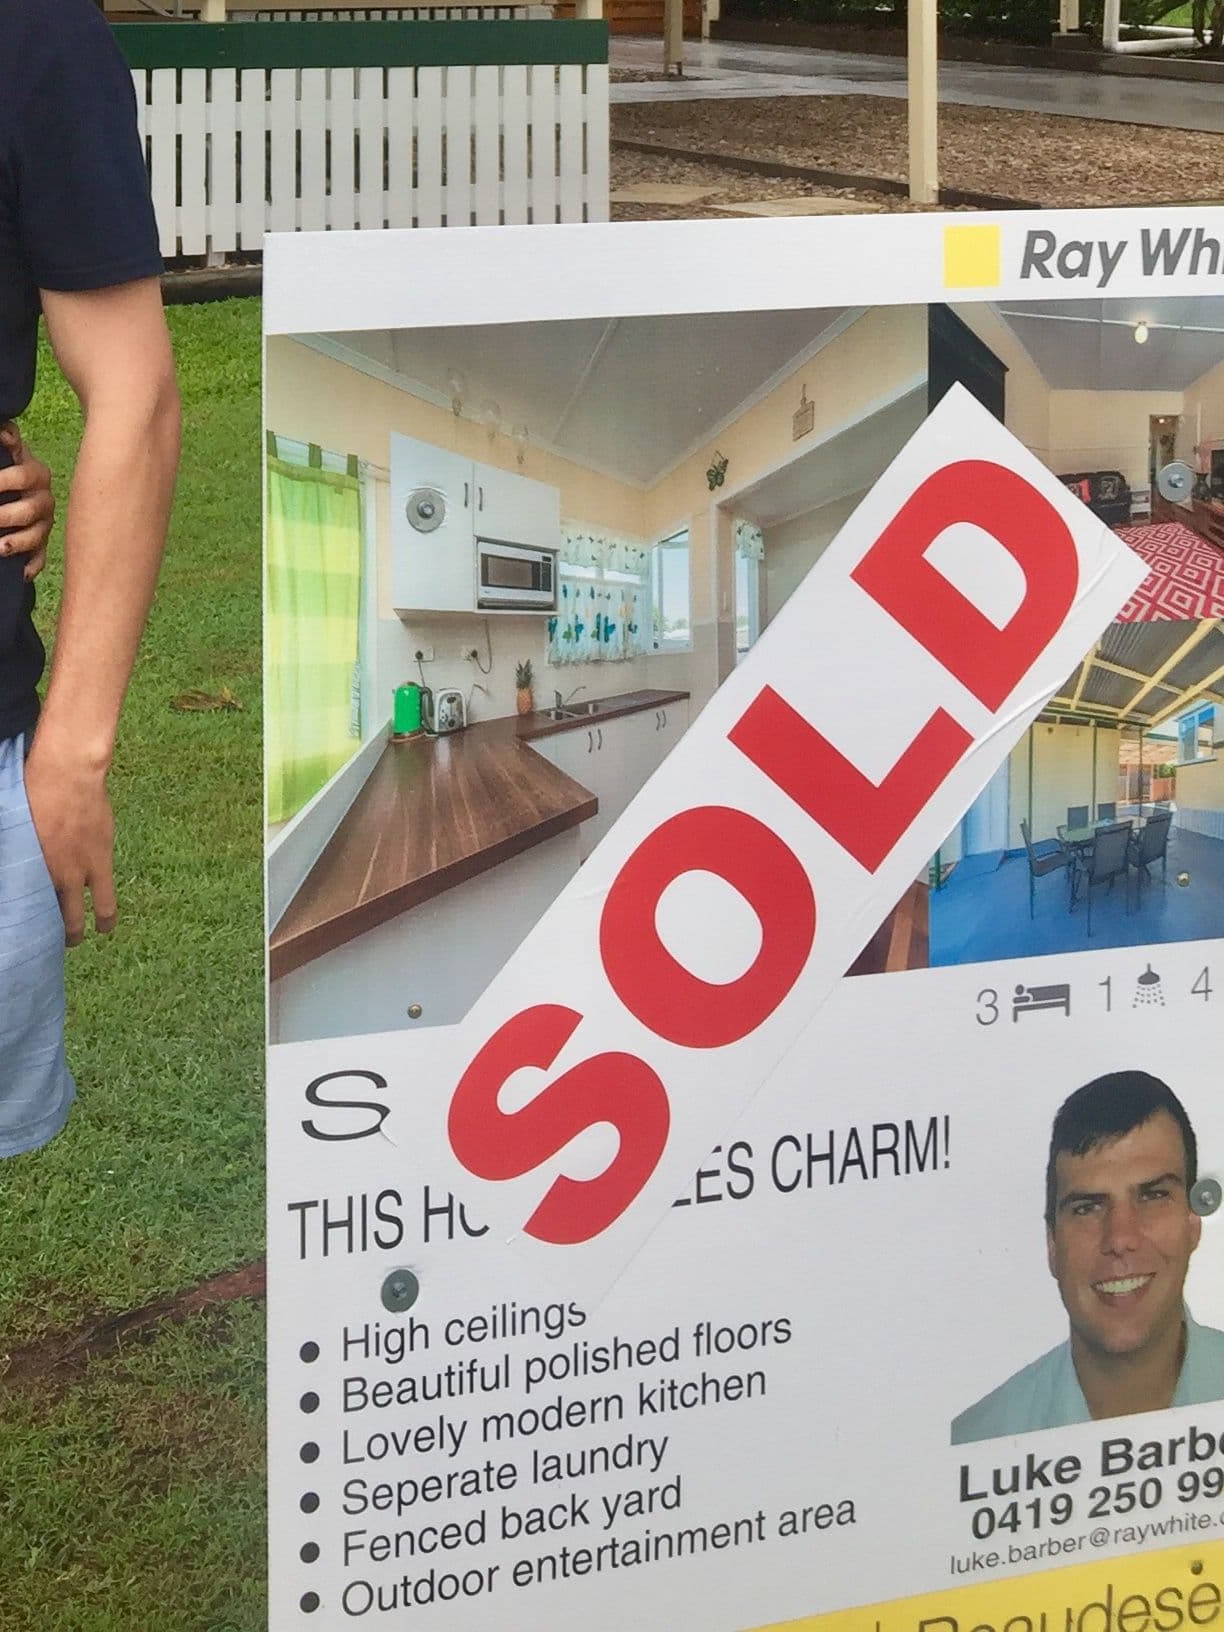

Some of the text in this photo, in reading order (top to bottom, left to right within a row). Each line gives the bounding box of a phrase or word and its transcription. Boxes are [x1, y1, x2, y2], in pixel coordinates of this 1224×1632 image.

[1020, 228, 1224, 288] Ray Wh
[448, 459, 1080, 1246] SOLD
[976, 966, 1213, 1025] 3 1 4
[287, 1188, 404, 1260] THIS
[671, 1141, 755, 1208] ES
[771, 1115, 950, 1193] CHARM!
[343, 1302, 587, 1364] High ceilings
[343, 1317, 792, 1412] Beautiful polished floors
[343, 1370, 766, 1464] Lovely modern kitchen
[342, 1434, 669, 1516] Seperate laundry
[960, 1426, 1224, 1503] Luke Barb
[972, 1467, 1224, 1540] 0419 250 99
[342, 1500, 857, 1616] Outdoor entertainment area
[343, 1475, 682, 1566] Fenced back yard
